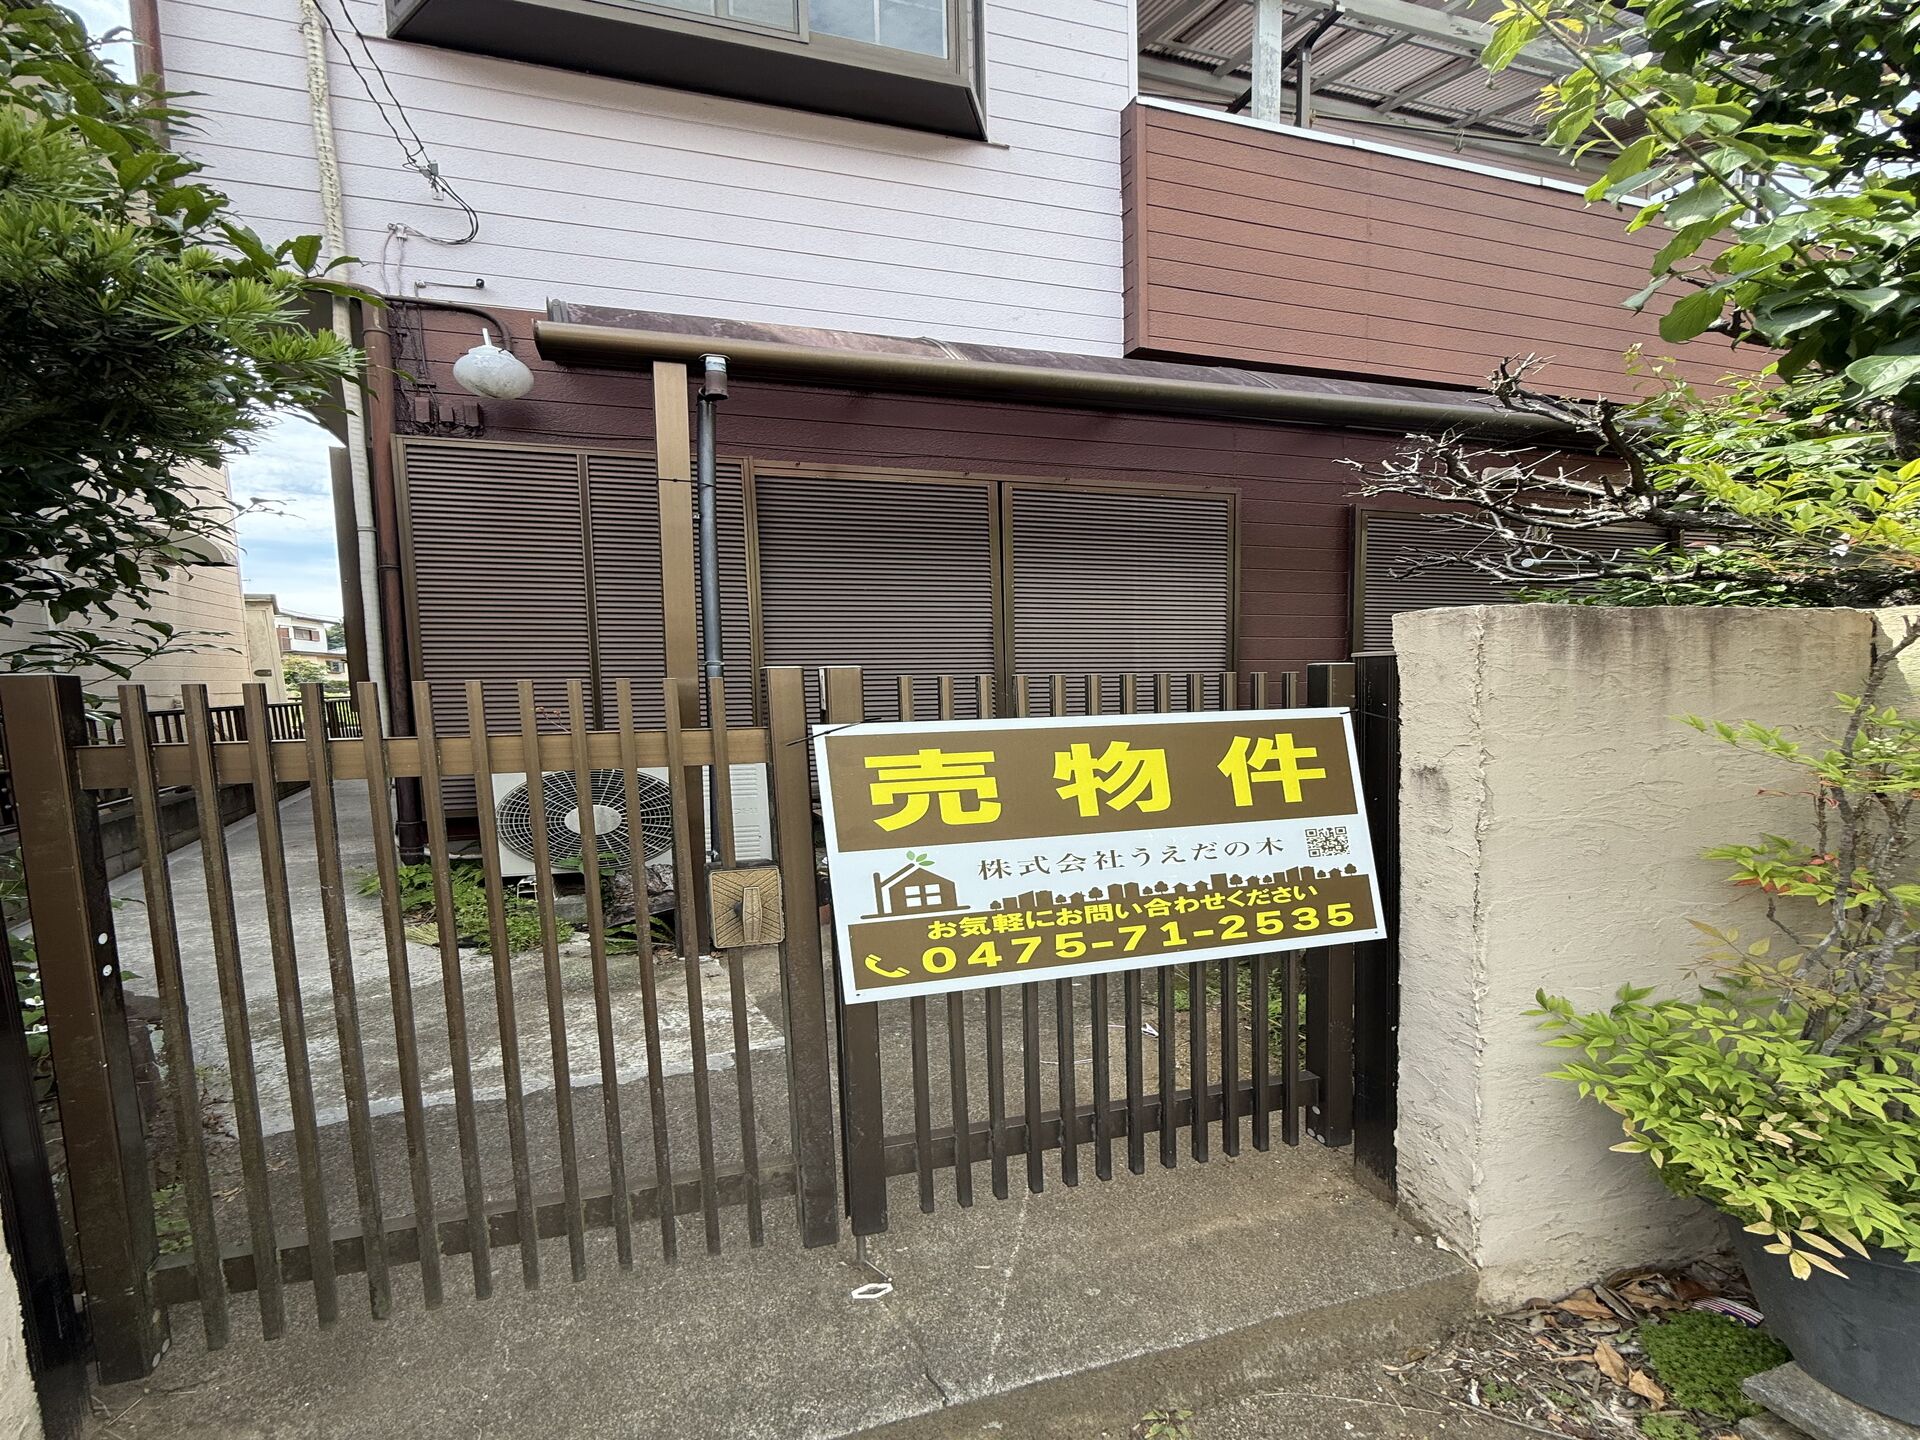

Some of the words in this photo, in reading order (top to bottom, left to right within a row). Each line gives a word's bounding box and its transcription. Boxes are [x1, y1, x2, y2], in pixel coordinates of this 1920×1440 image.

[863, 733, 1328, 832] 売物件
[978, 836, 1285, 881] 株式会社うえだの木
[920, 902, 1356, 974] 0475-71-2535
[927, 884, 1319, 940] お気軽にお問い合わせください
